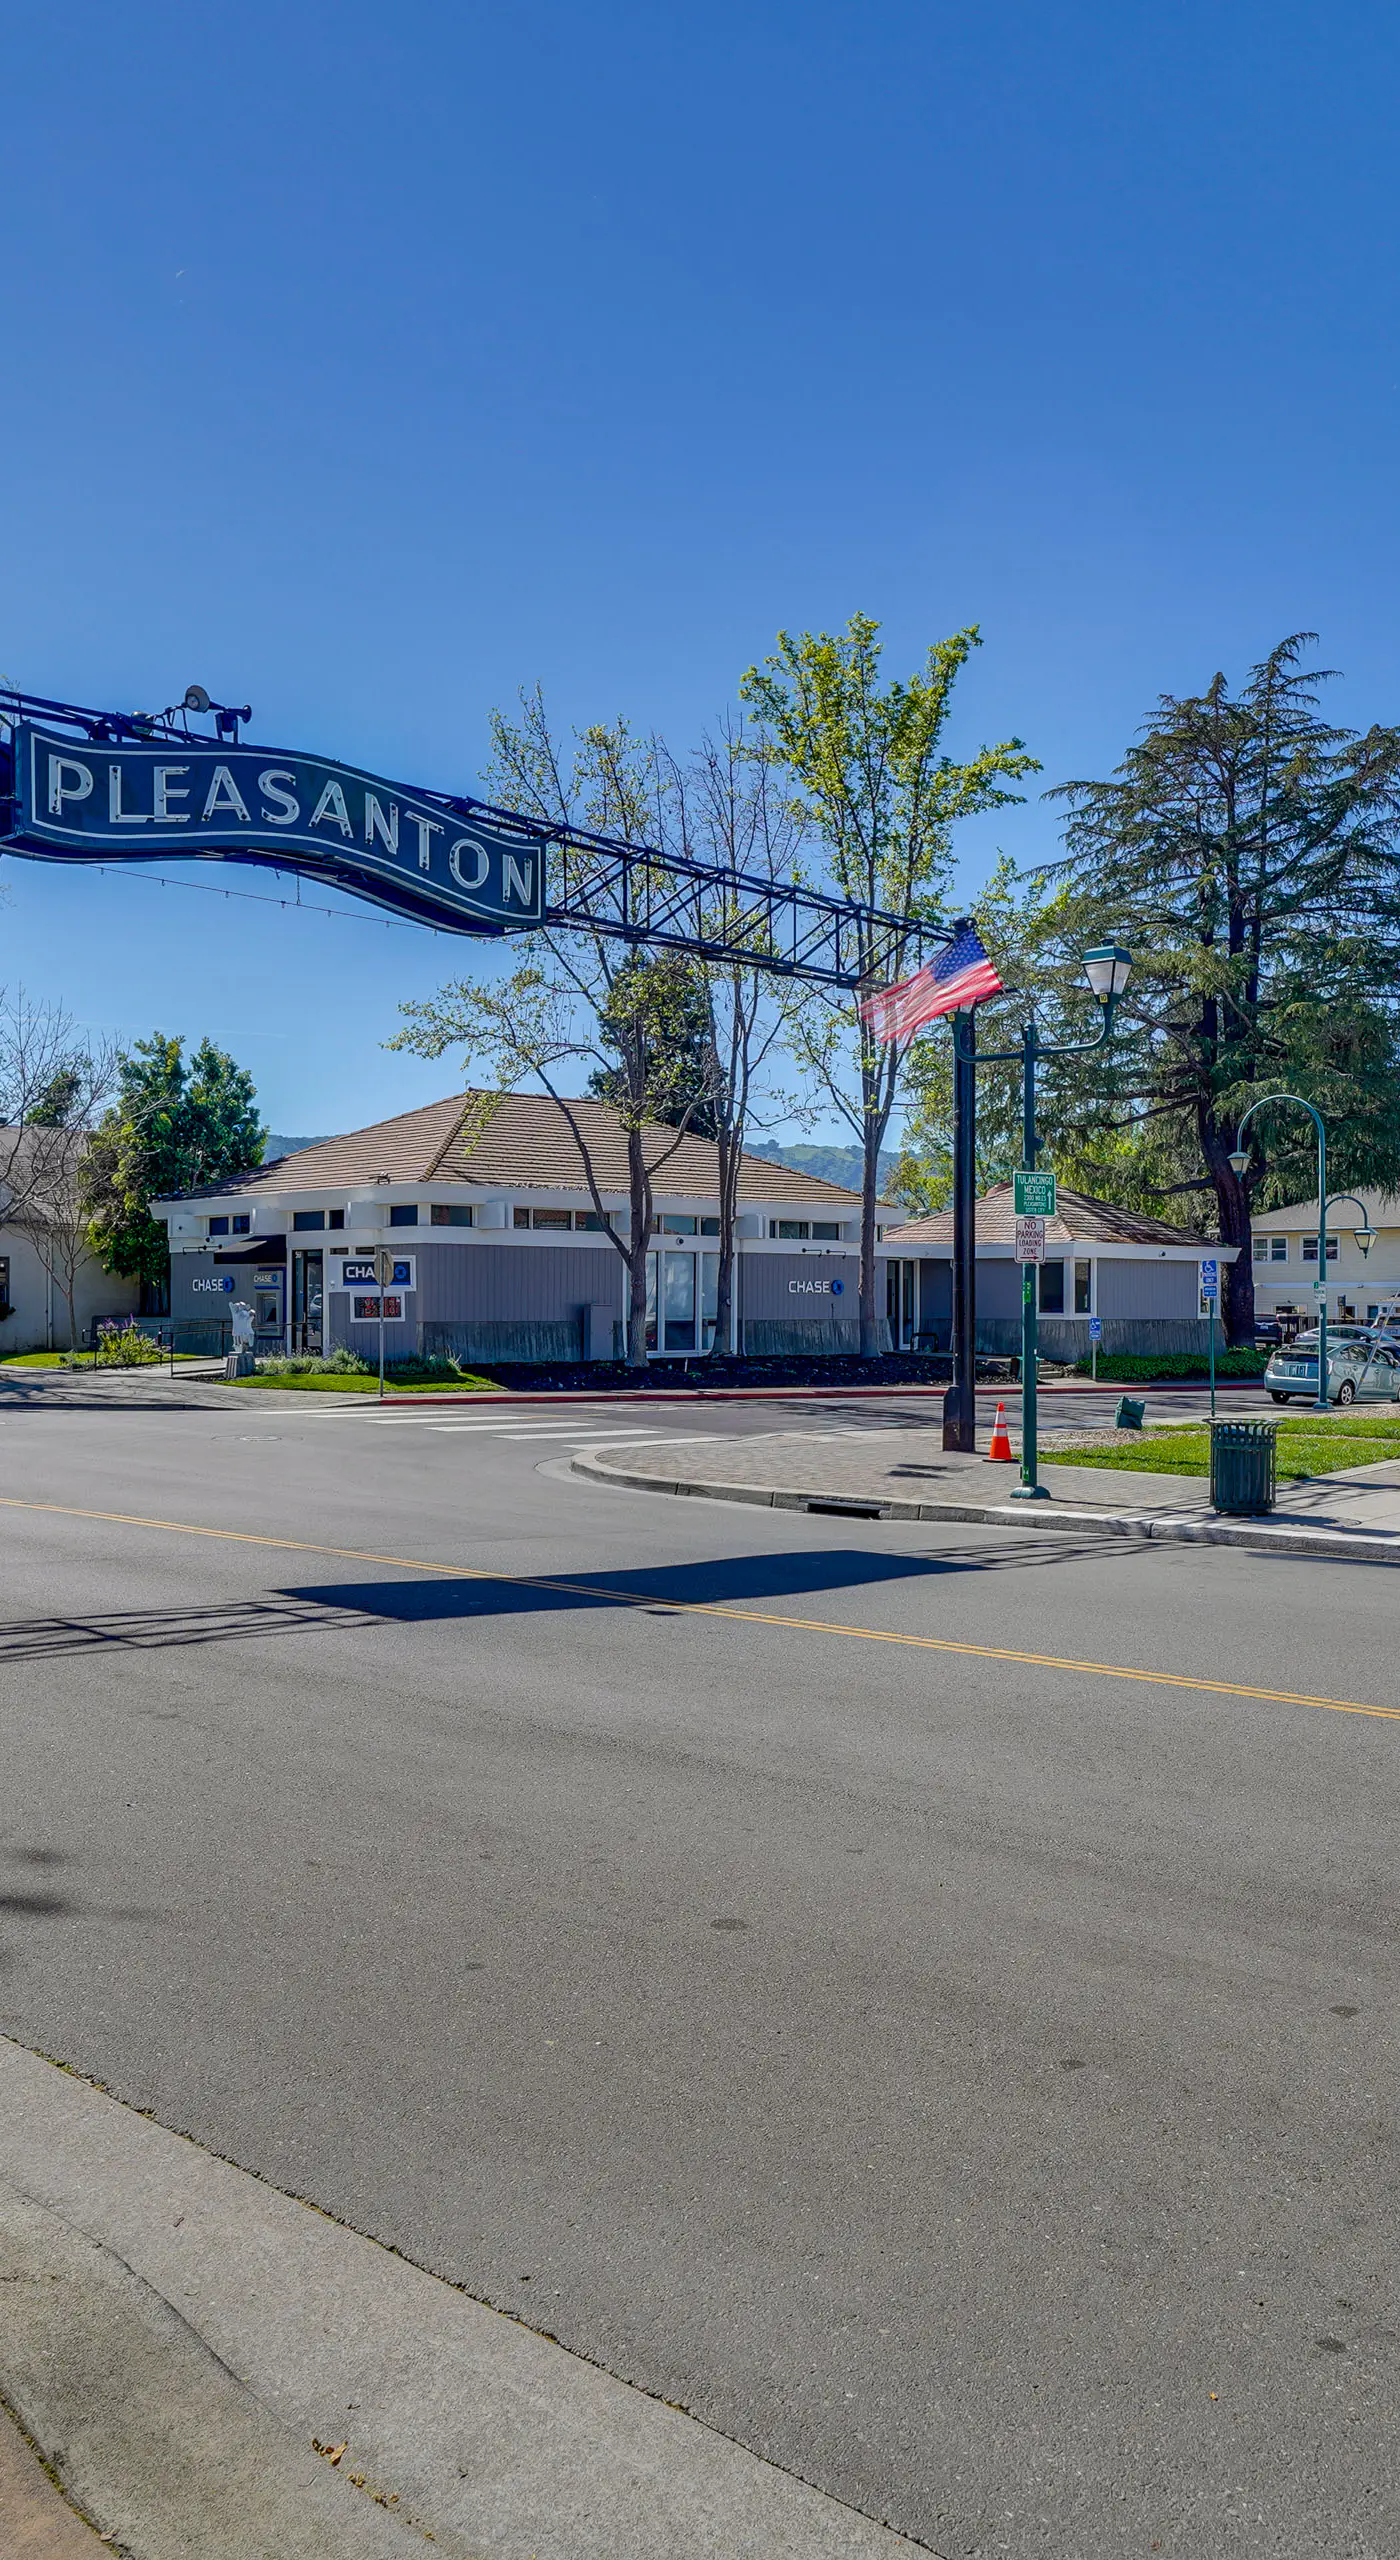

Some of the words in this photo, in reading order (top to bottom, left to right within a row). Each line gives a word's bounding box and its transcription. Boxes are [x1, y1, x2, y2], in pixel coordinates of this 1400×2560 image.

[47, 753, 533, 907] PLEASANTON
[1023, 1185, 1046, 1195] MEXICO
[1024, 1221, 1037, 1230] NO
[1017, 1230, 1044, 1239] PARKING
[1019, 1239, 1042, 1247] LOADING
[1023, 1247, 1037, 1255] ZONE
[253, 1275, 273, 1283] CHASE
[192, 1278, 224, 1292] CHASE
[788, 1280, 831, 1293] CHASE
